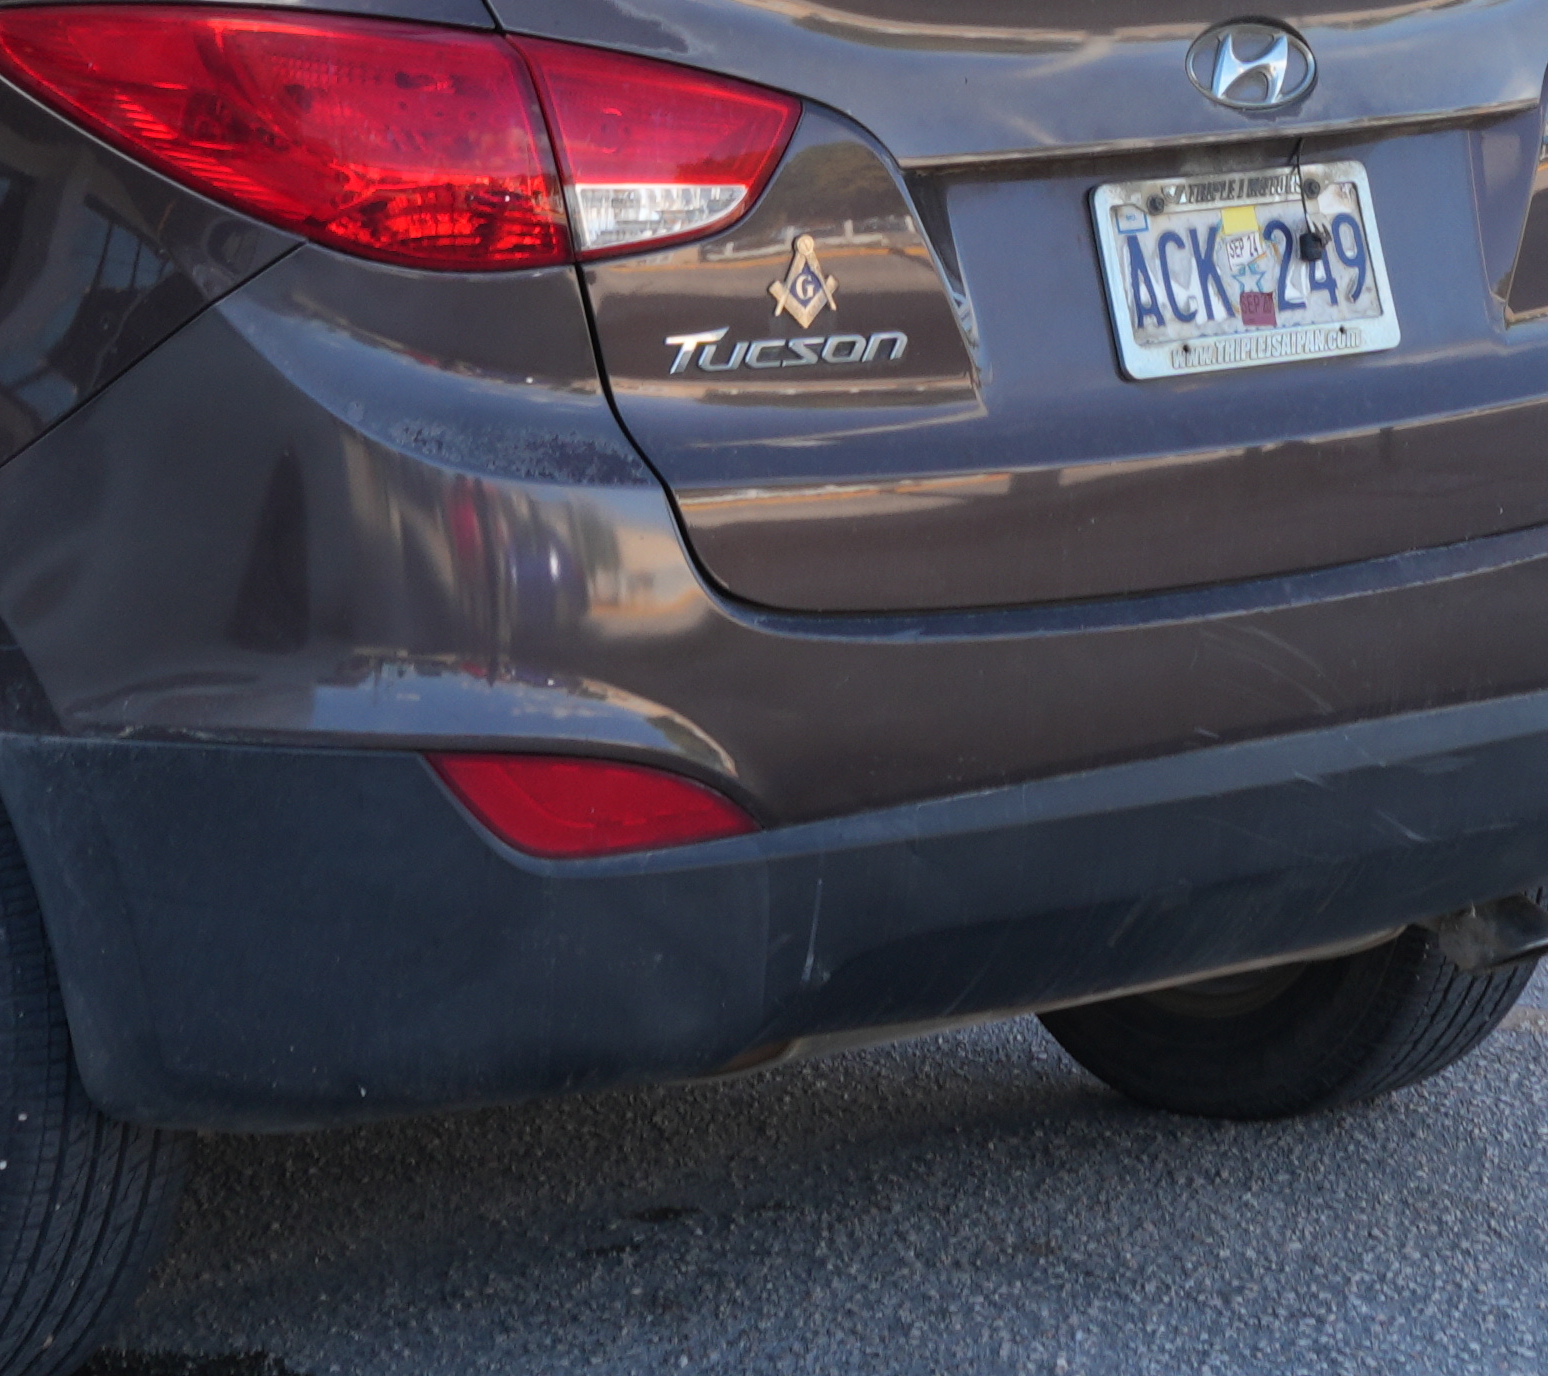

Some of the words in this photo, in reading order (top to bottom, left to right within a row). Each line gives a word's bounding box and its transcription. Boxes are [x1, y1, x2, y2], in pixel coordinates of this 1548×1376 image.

[1228, 238, 1245, 259] SEP
[1126, 225, 1236, 329] ACK
[1262, 213, 1368, 312] 249
[794, 274, 816, 300] G
